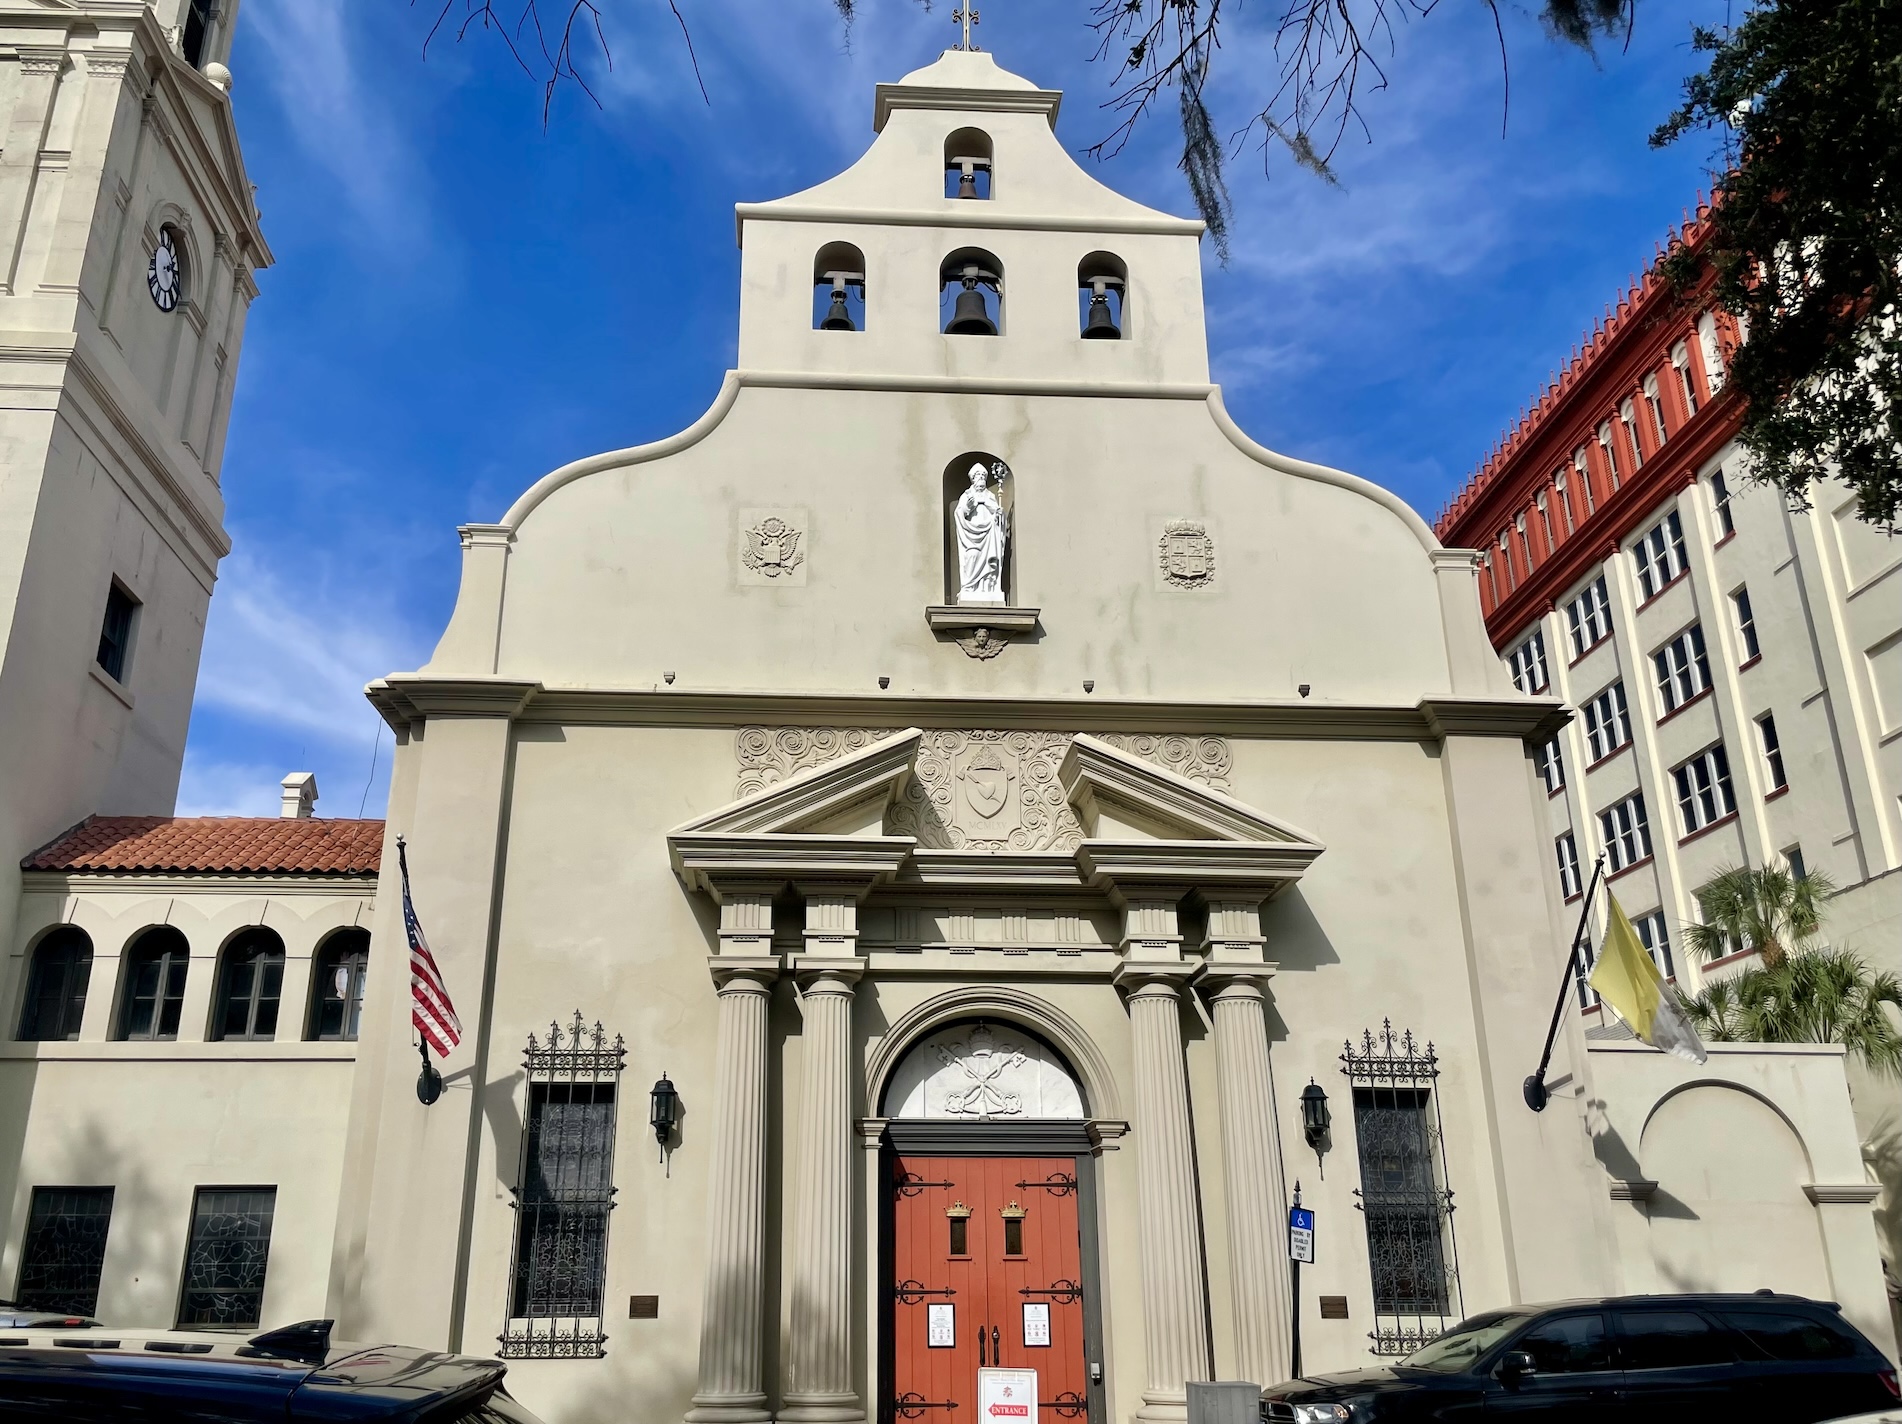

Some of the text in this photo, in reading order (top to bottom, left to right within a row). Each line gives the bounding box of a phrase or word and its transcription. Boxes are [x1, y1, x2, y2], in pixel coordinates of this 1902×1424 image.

[1293, 1237, 1309, 1245] DISABLED
[1295, 1244, 1307, 1252] PERMIT
[991, 1406, 1027, 1415] ENTRANCE
